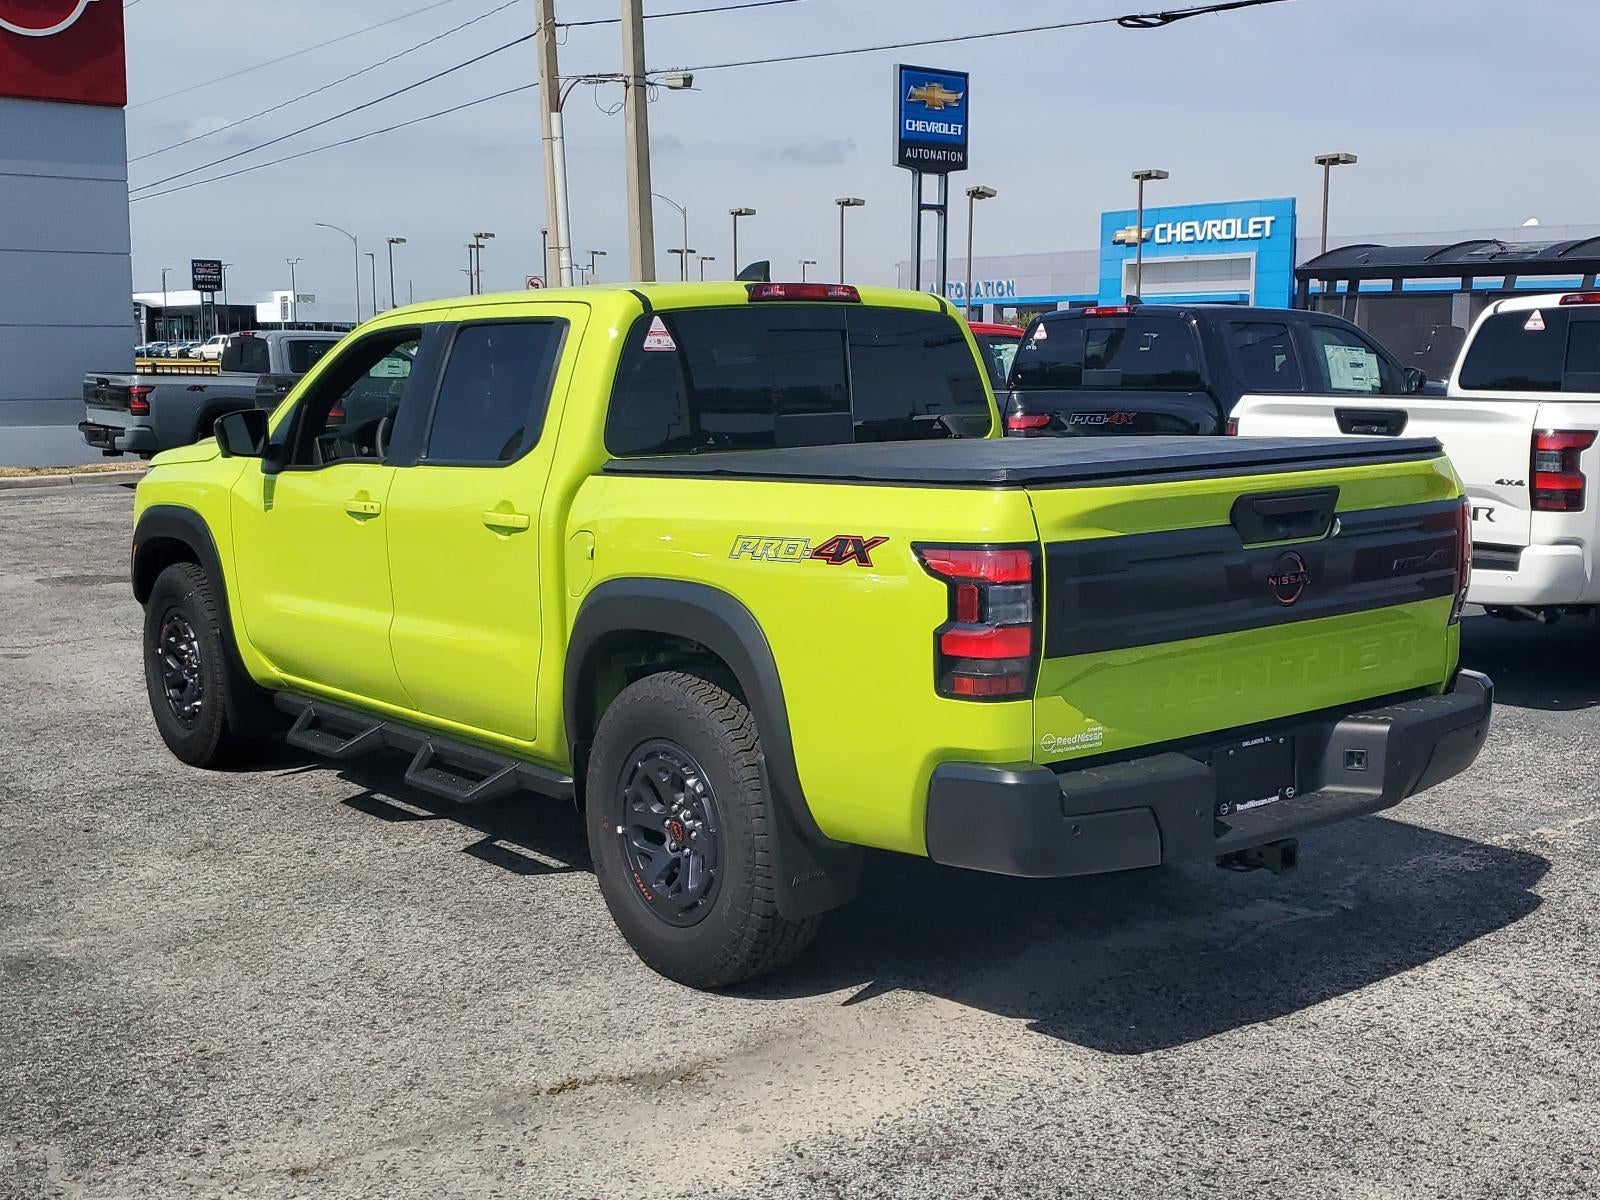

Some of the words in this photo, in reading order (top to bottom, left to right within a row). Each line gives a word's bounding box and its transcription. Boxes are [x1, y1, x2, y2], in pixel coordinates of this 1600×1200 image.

[905, 119, 964, 136] CHEVROLET
[905, 147, 963, 162] AUTONATION
[1154, 215, 1276, 245] CHEVROLET
[1069, 412, 1137, 425] PRO-4X
[728, 534, 890, 568] PRO-4X
[1267, 573, 1312, 587] NISSAN
